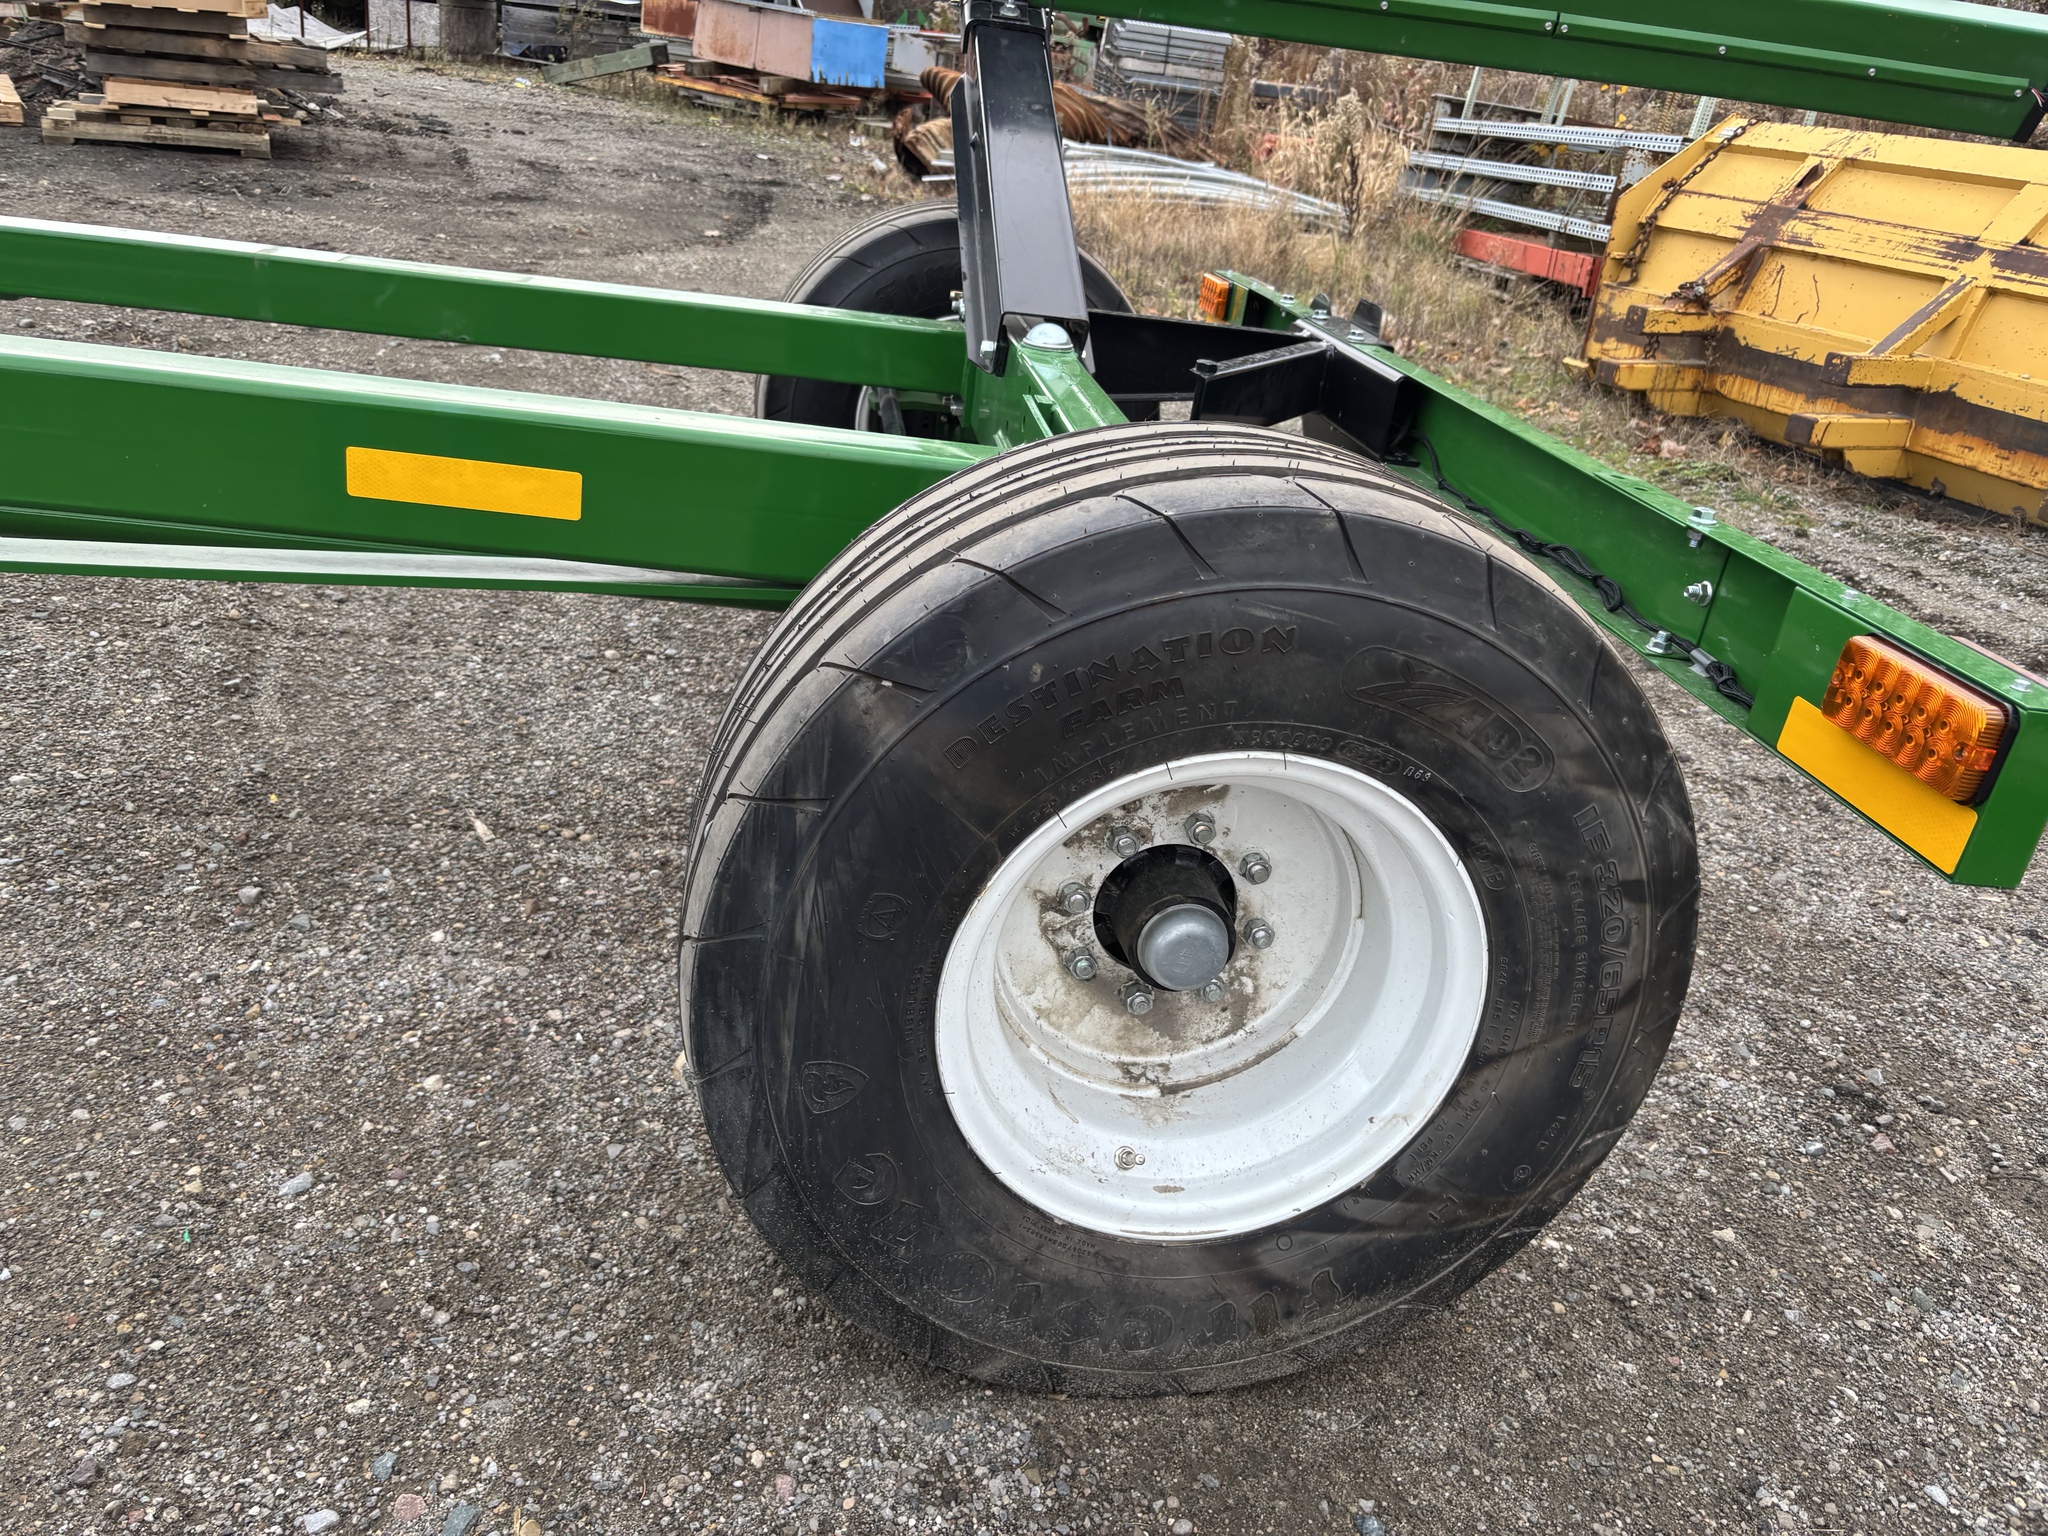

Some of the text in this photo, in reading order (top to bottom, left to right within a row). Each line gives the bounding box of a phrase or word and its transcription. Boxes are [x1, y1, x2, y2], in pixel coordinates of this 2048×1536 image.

[943, 626, 1298, 770] DESTINATION
[1060, 675, 1184, 738] FARM
[1035, 701, 1239, 782] IMPLEMENT
[1434, 697, 1544, 785] AD2
[1566, 871, 1588, 945] REPLACES
[1569, 805, 1626, 1090] IF 320/65R15
[1496, 1026, 1514, 1054] LOAD
[1507, 1000, 1521, 1021] MAX
[1461, 1098, 1481, 1120] MPH
[1019, 1213, 1096, 1249] MADE IN COSTA RICA
